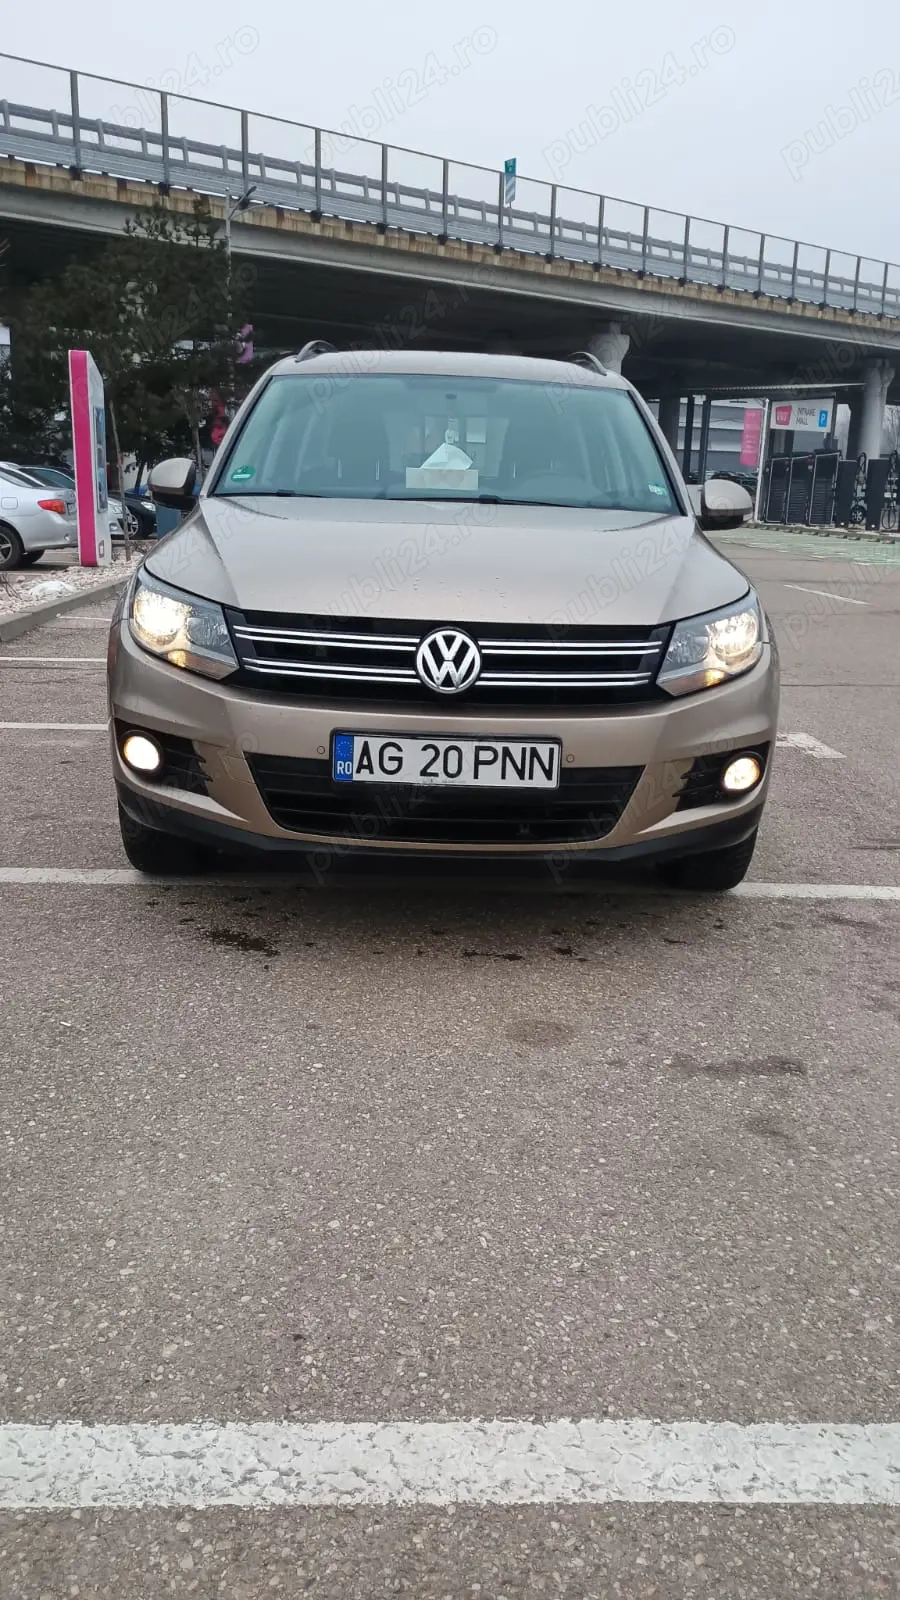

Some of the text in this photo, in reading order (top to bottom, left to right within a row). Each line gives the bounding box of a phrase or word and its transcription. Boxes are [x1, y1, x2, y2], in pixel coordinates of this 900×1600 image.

[336, 760, 353, 776] RO
[355, 740, 555, 781] AG 20 PNN
